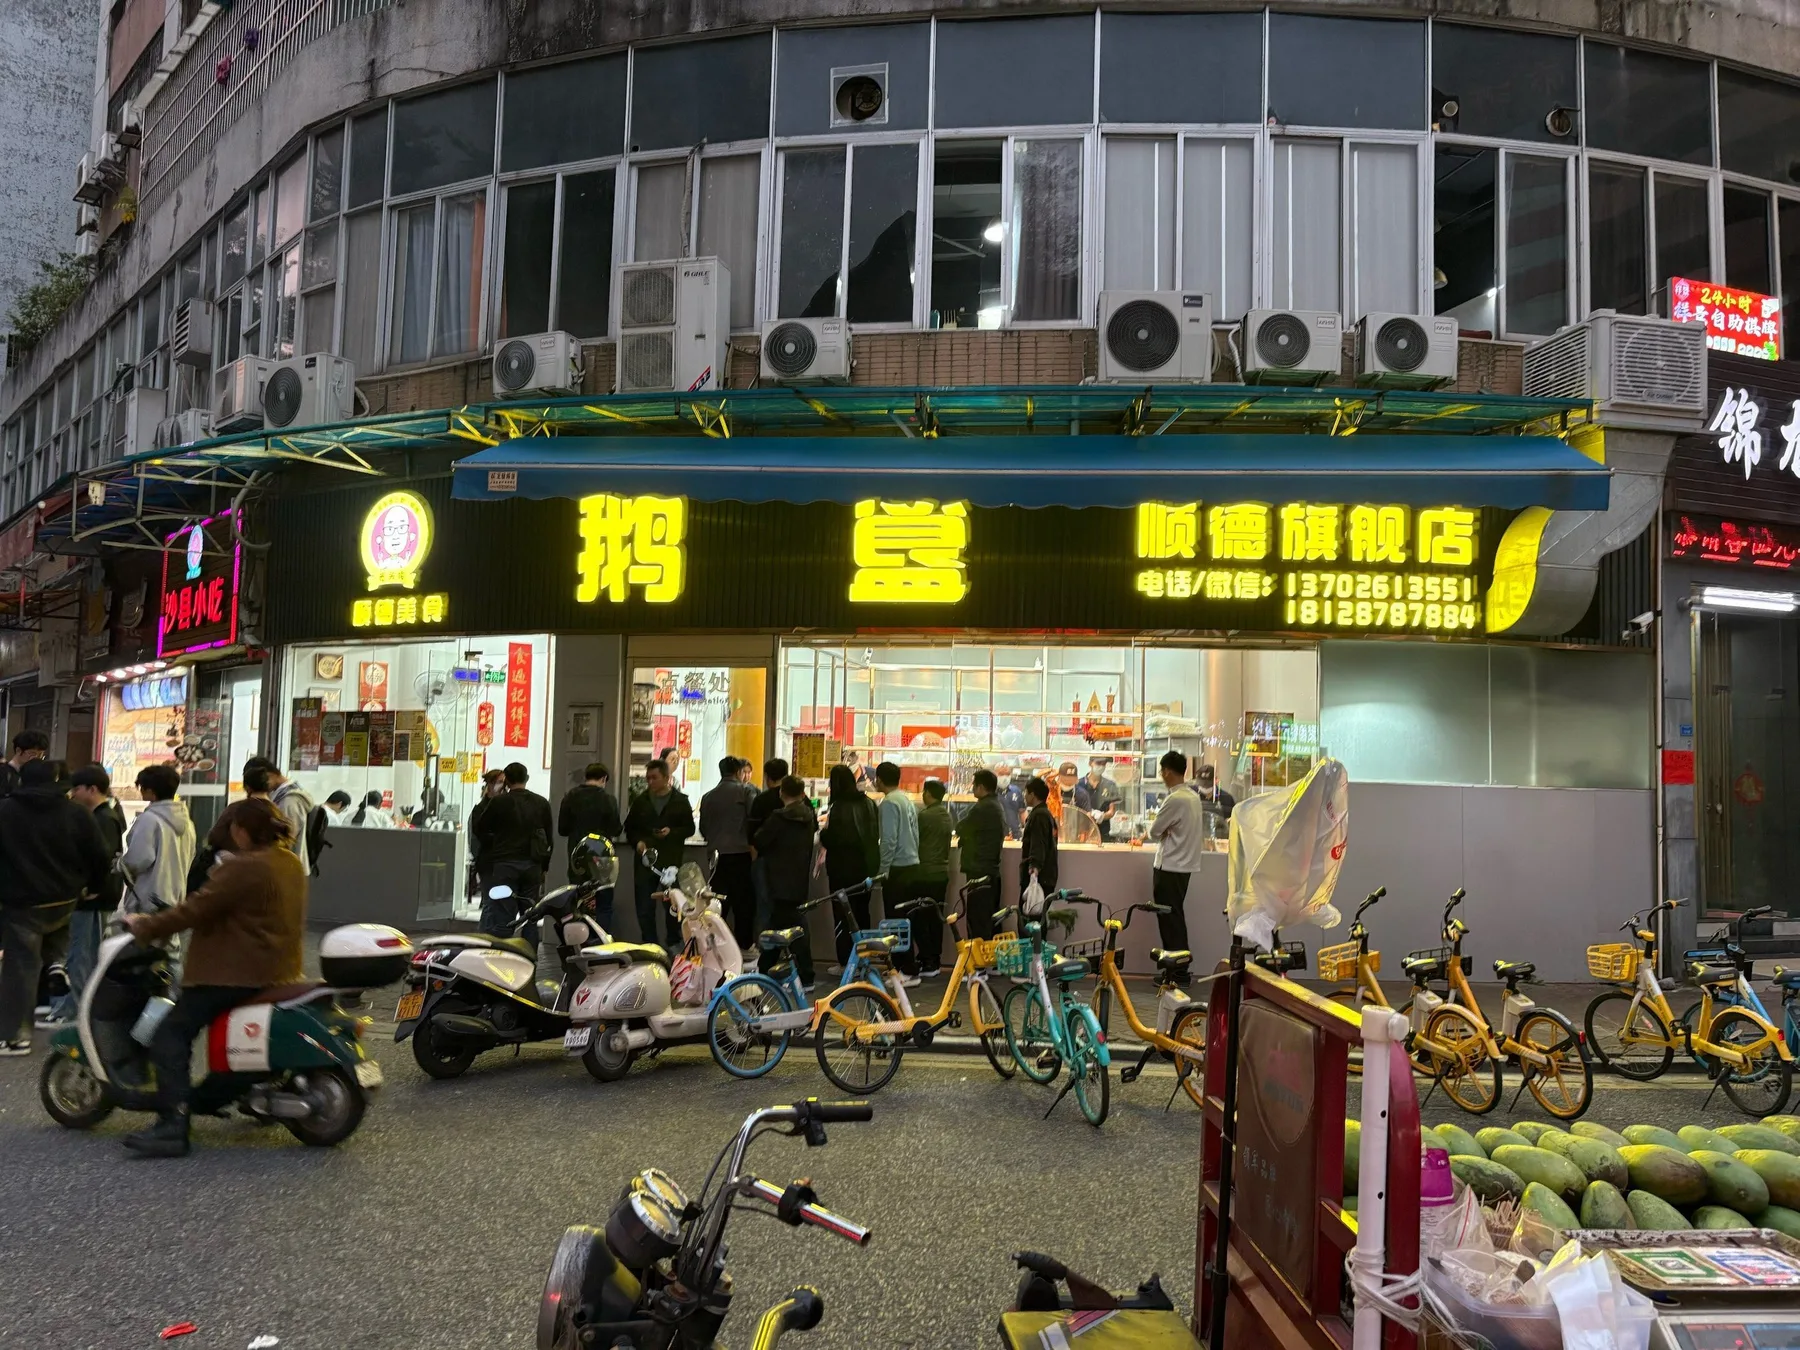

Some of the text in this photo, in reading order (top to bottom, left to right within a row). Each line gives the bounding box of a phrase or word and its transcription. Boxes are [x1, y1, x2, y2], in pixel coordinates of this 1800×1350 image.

[1700, 287, 1753, 315] 24小时
[1138, 502, 1474, 566] 顺德旗舰店
[1287, 573, 1472, 602] 13702613551
[164, 577, 224, 634] 沙县小吃
[1287, 599, 1476, 629] 18128787884
[662, 671, 730, 693] 点餐处
